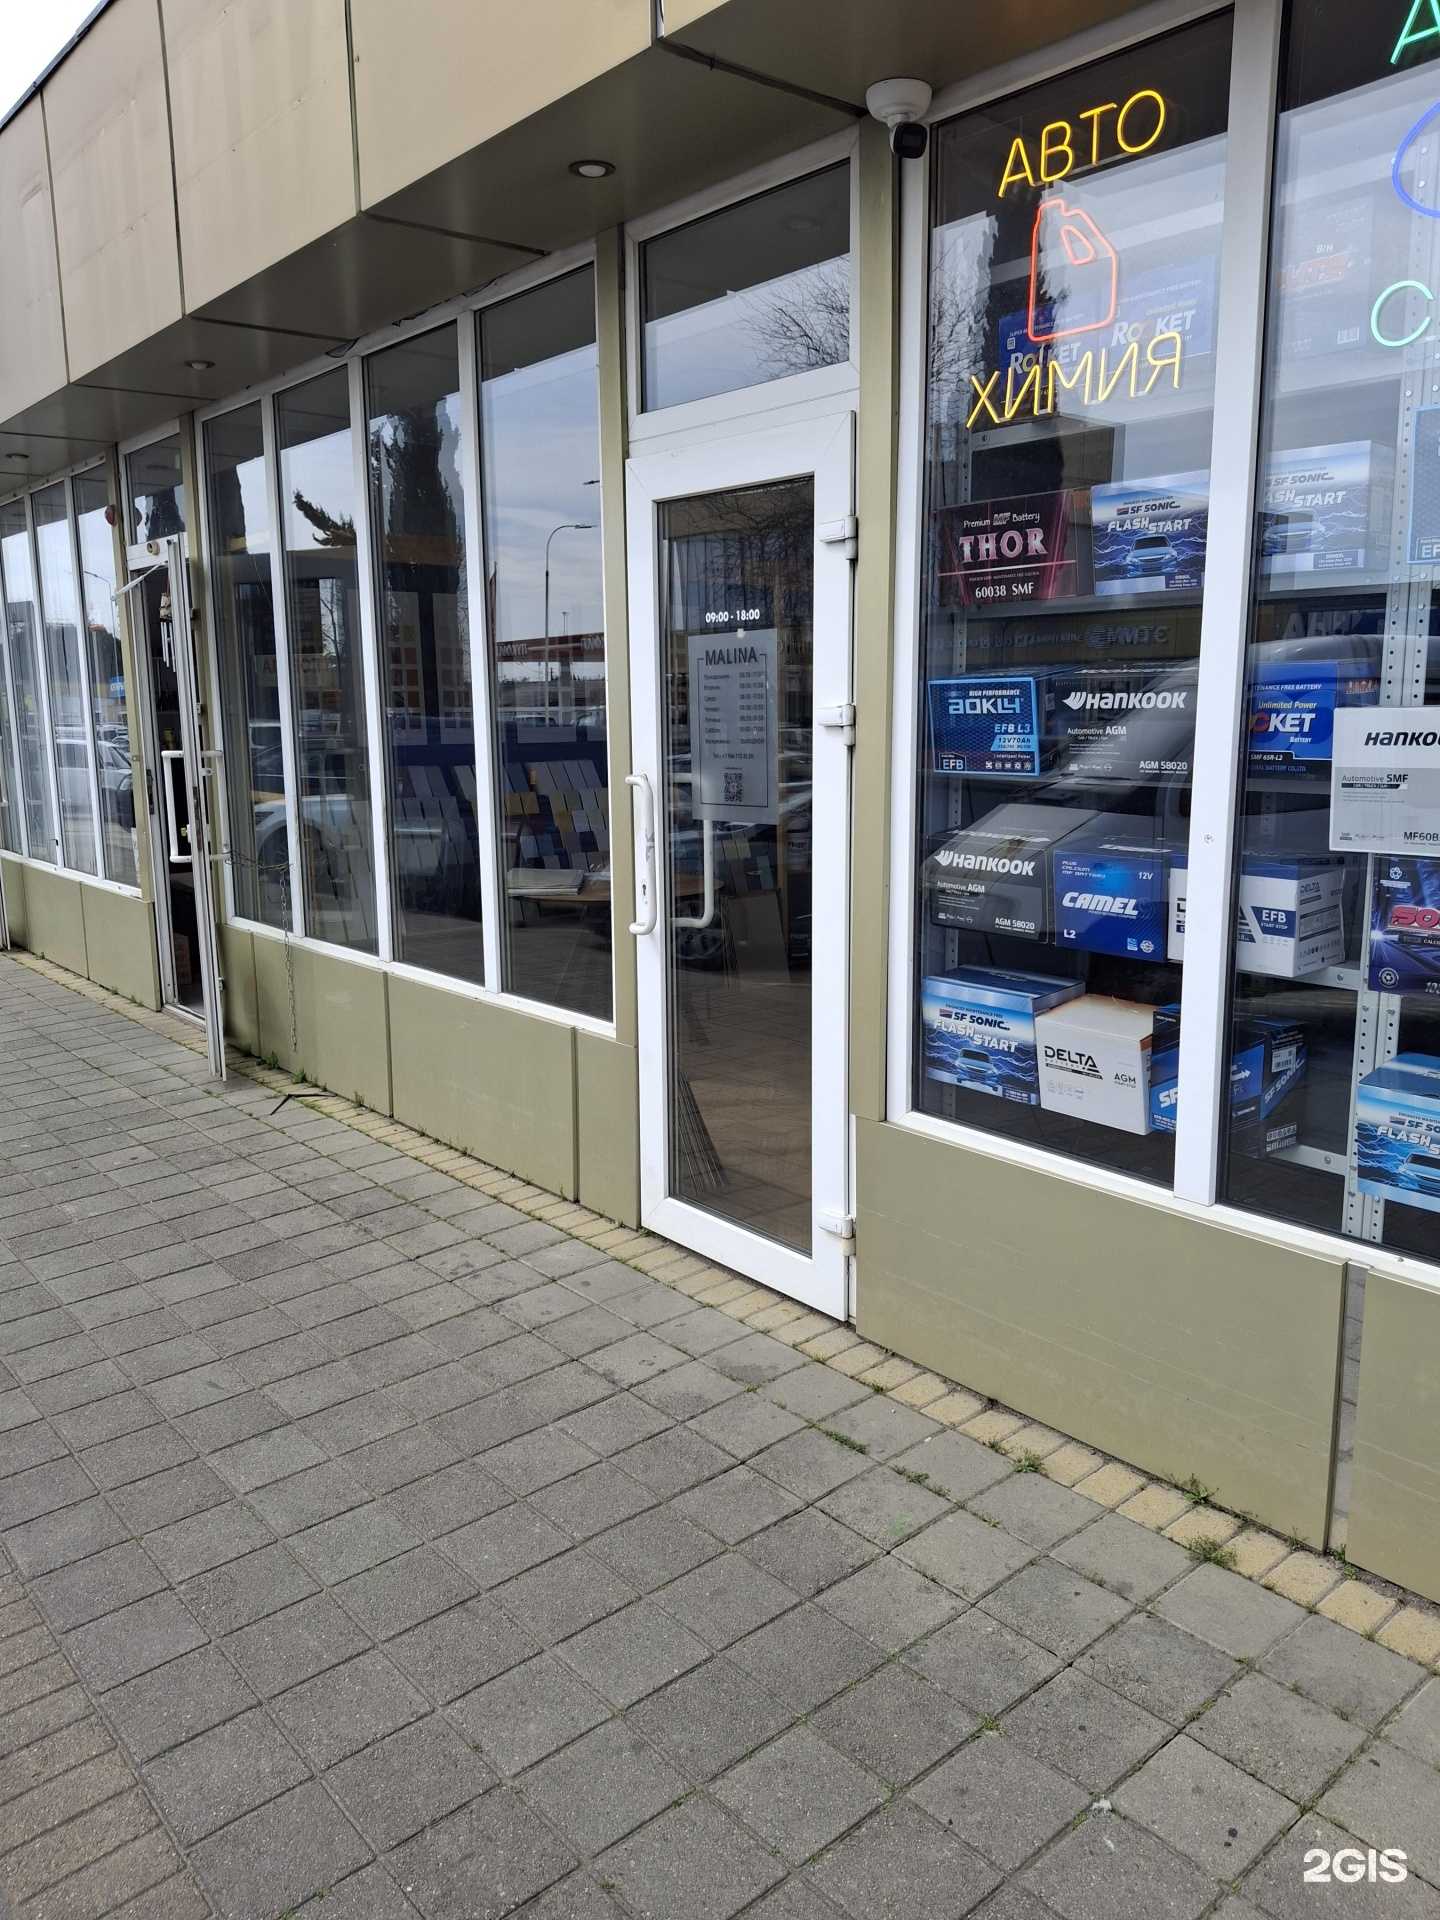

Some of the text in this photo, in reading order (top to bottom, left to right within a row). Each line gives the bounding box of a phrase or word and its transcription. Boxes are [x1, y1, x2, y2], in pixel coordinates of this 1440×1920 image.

[998, 90, 1165, 198] АВТО
[967, 332, 1181, 428] ХИМИЯ
[1294, 490, 1346, 508] START
[1130, 501, 1181, 514] SF SONIC
[963, 518, 991, 528] Premium
[1012, 512, 1040, 523] Battery
[1107, 517, 1192, 534] FLASH START
[959, 528, 1048, 563] THOR
[975, 582, 1034, 598] 60038 SMF
[705, 611, 729, 623] 09:00
[736, 609, 760, 621] 18:00
[705, 647, 758, 666] MALINA
[1258, 701, 1318, 709] Unlimited Power
[994, 723, 1031, 733] EFB L3
[1105, 726, 1127, 735] AGM
[943, 759, 964, 770] EFB
[1139, 761, 1188, 770] AGM 58020
[1342, 774, 1408, 783] Automotive SMF
[1138, 871, 1154, 880] 12V
[937, 881, 967, 891] Automotive
[967, 883, 985, 893] AGM
[1062, 892, 1139, 916] CAMEL
[994, 917, 1011, 927] AGM
[1012, 920, 1036, 930] 58020
[1262, 910, 1287, 923] EFB
[1391, 905, 1440, 928] SO
[1063, 929, 1077, 939] L2
[953, 1012, 1010, 1031] SF SONIC
[934, 1021, 1018, 1053] FLASH START
[1044, 1046, 1099, 1072] DELTA
[1114, 1073, 1136, 1084] AGM
[1407, 1119, 1423, 1129] SF
[1377, 1126, 1431, 1147] FLASH
